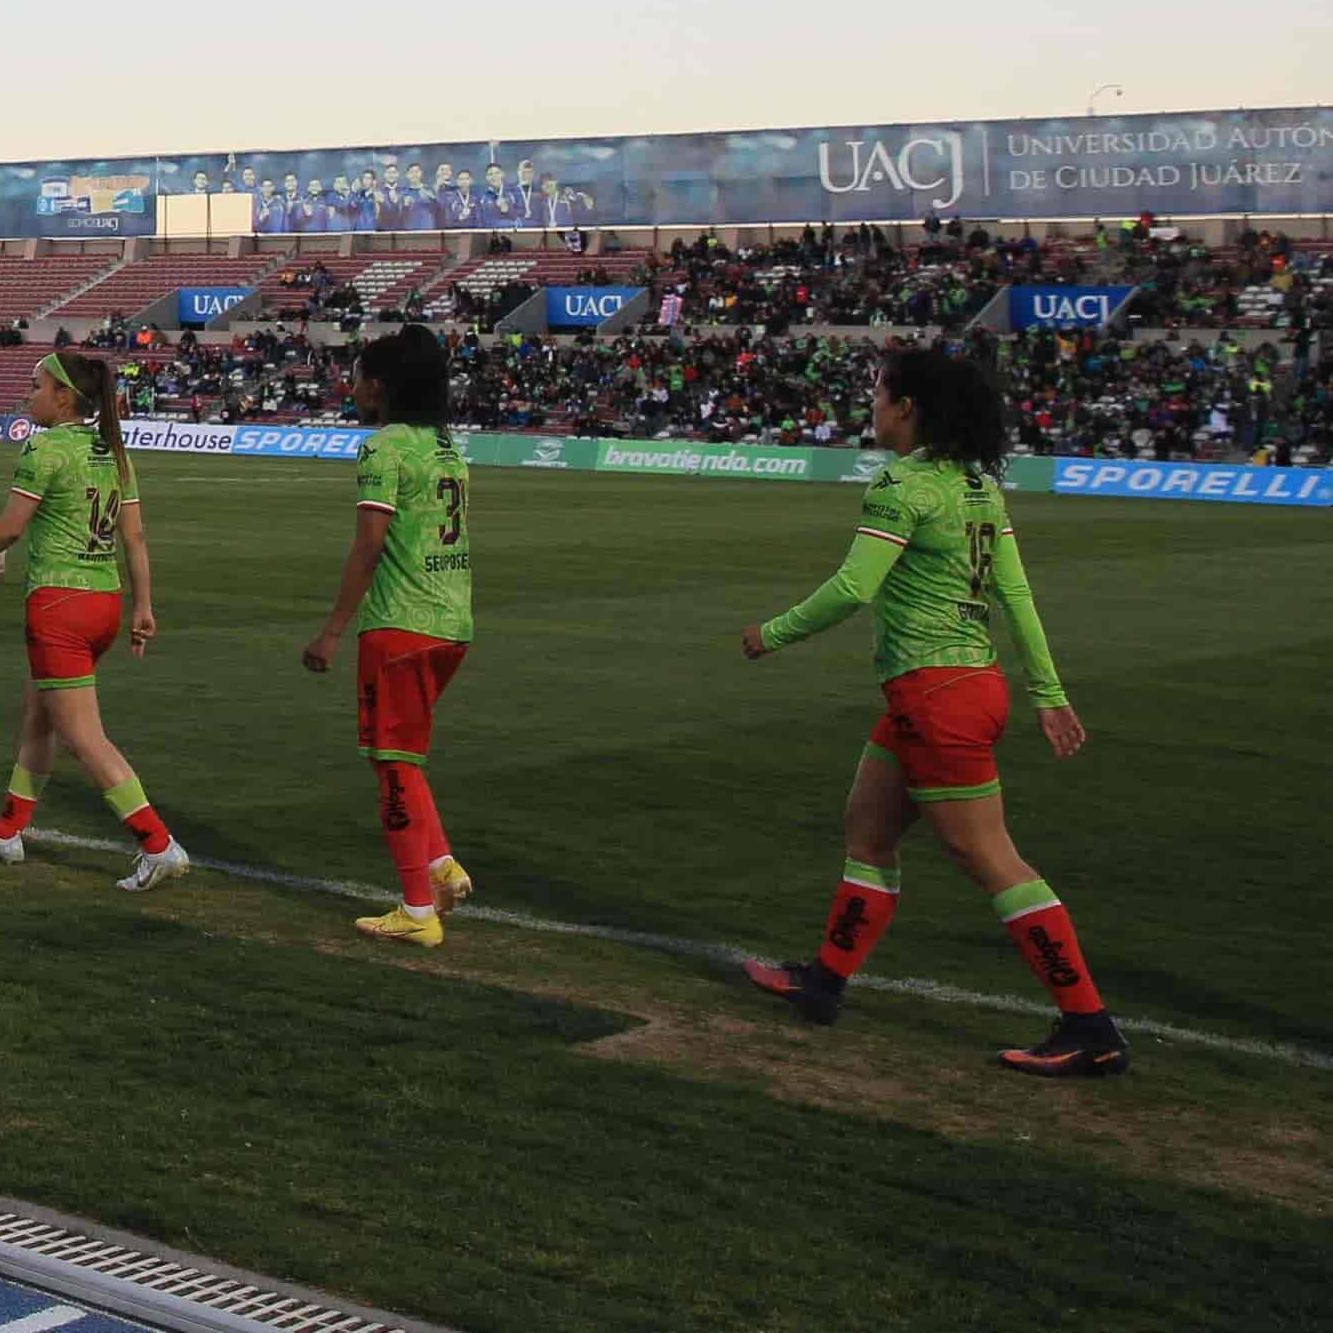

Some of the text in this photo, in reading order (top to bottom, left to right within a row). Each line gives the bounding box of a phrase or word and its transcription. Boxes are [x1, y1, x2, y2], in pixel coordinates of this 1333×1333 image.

[1007, 131, 1216, 156] UNIVERSIDAD
[818, 131, 964, 209] UACJ
[1054, 165, 1181, 189] CIUDAD
[1190, 158, 1303, 190] JUÁREZ
[194, 294, 244, 315] UAC
[1033, 294, 1109, 329] UACJ
[122, 423, 232, 451] aterhouse
[603, 445, 807, 475] bravotienda.com
[1056, 464, 1321, 499] SPORELLI
